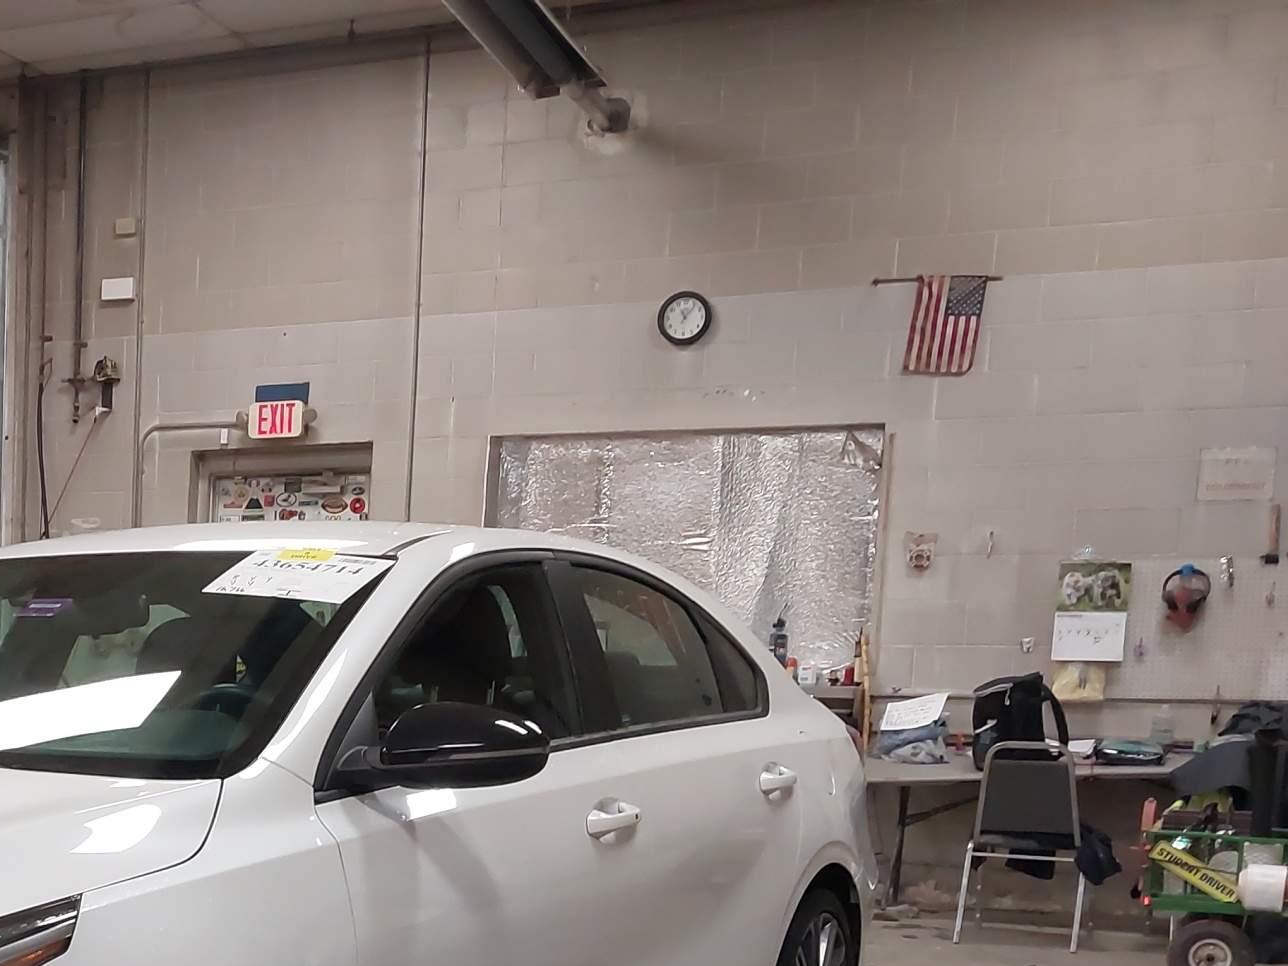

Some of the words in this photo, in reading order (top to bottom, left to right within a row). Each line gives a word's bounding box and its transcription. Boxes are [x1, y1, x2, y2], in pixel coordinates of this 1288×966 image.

[258, 403, 295, 434] EXIT
[1156, 848, 1200, 877] STUDENT
[1199, 872, 1236, 897] DRIVER
